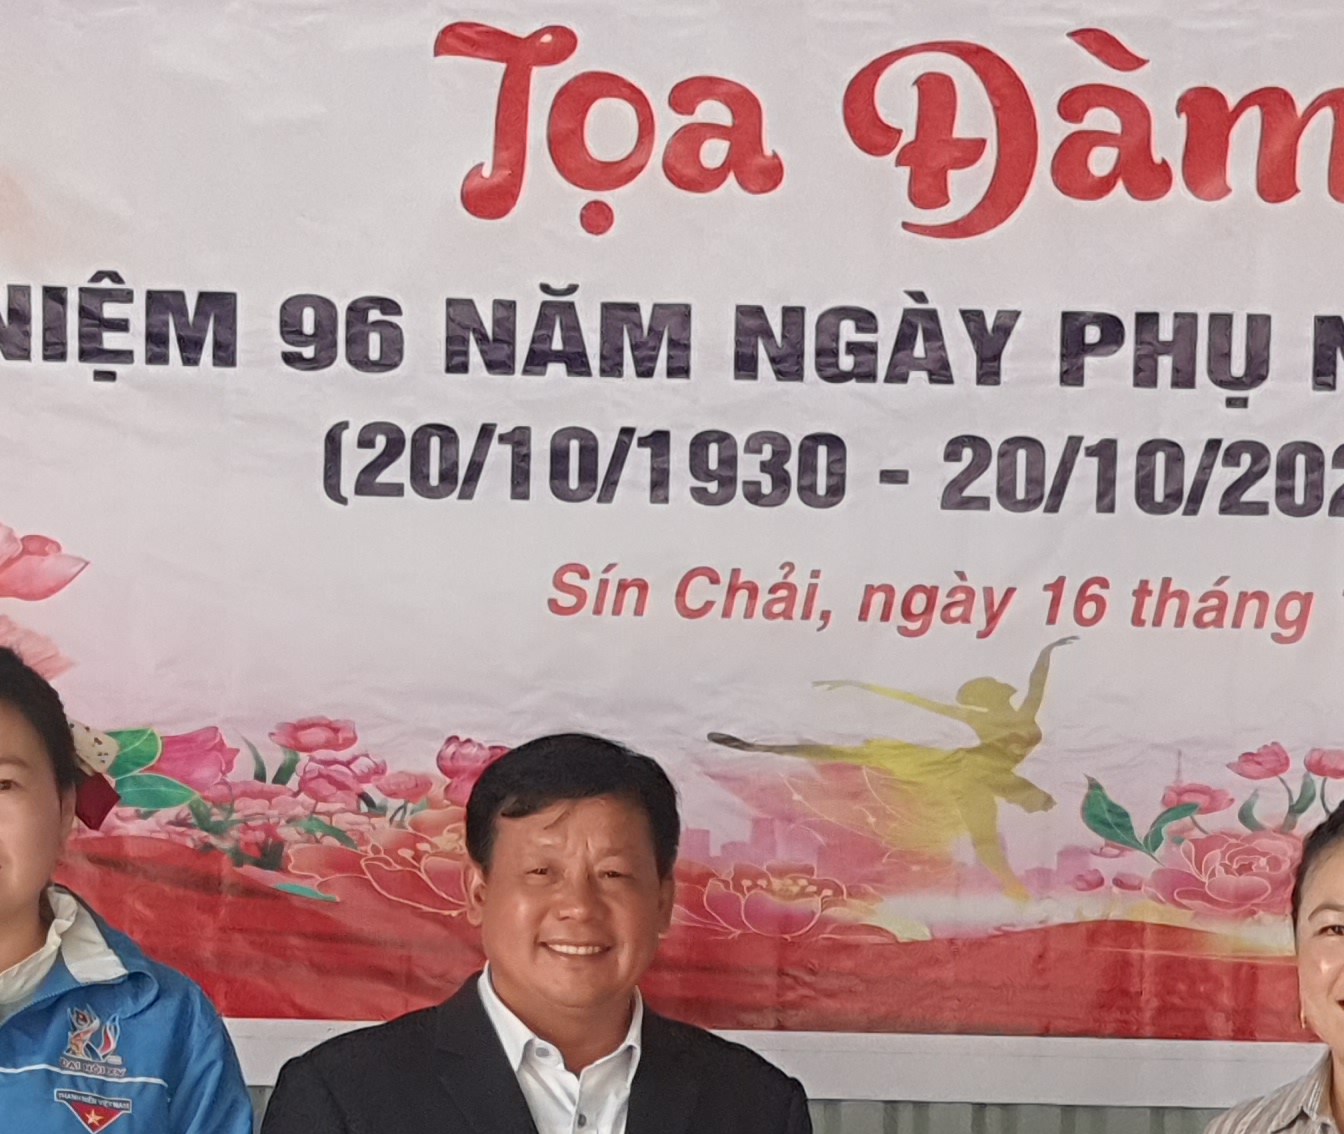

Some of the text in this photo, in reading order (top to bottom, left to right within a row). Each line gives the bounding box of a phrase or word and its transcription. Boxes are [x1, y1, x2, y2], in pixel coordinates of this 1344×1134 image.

[433, 21, 785, 236] Tọa
[278, 293, 405, 374] 96
[443, 282, 693, 380] NĂM
[732, 290, 1023, 387] NGÀY
[1058, 310, 1273, 409] PHỤ
[322, 419, 848, 510] (20/10/1930
[878, 468, 910, 486] -
[547, 562, 650, 617] Sín
[674, 561, 832, 633] Chải,
[857, 570, 1017, 640] ngày
[1041, 576, 1111, 627] 16
[1129, 577, 1315, 645] tháng
